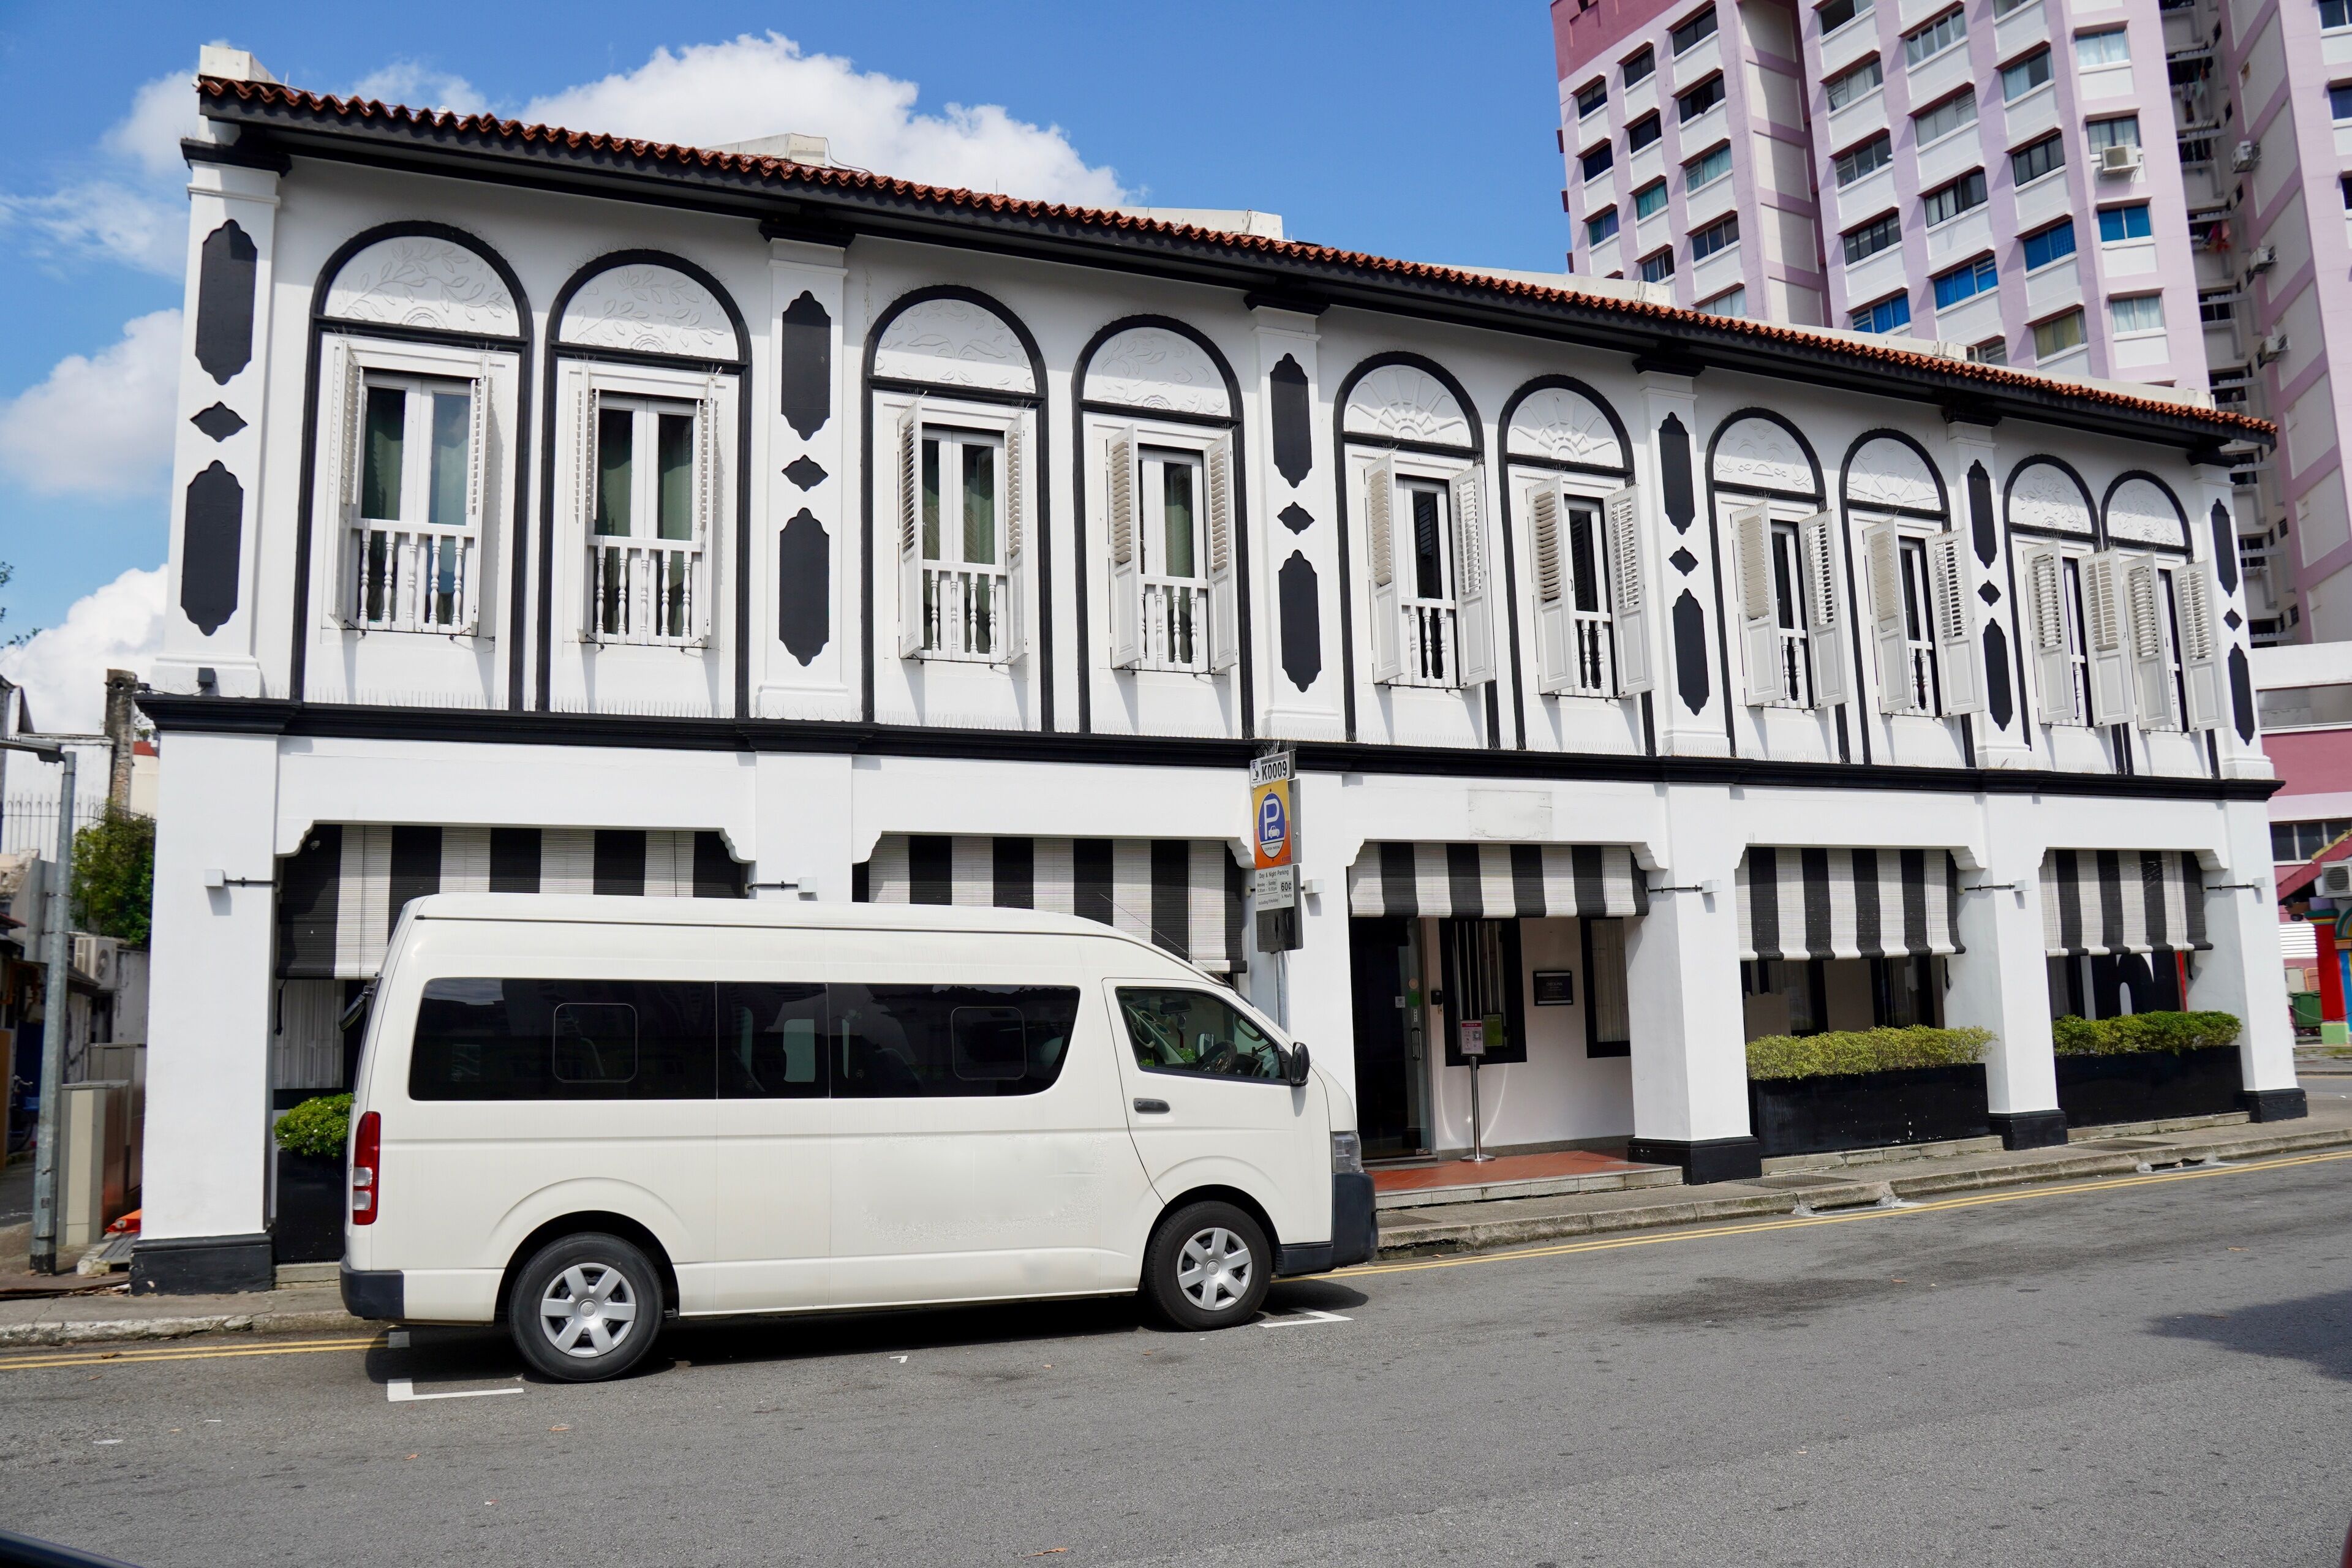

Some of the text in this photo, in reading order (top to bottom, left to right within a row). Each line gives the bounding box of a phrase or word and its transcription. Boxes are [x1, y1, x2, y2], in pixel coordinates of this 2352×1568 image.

[1262, 761, 1287, 781] K0009
[1264, 798, 1280, 840] P
[1281, 882, 1292, 891] 60¢
